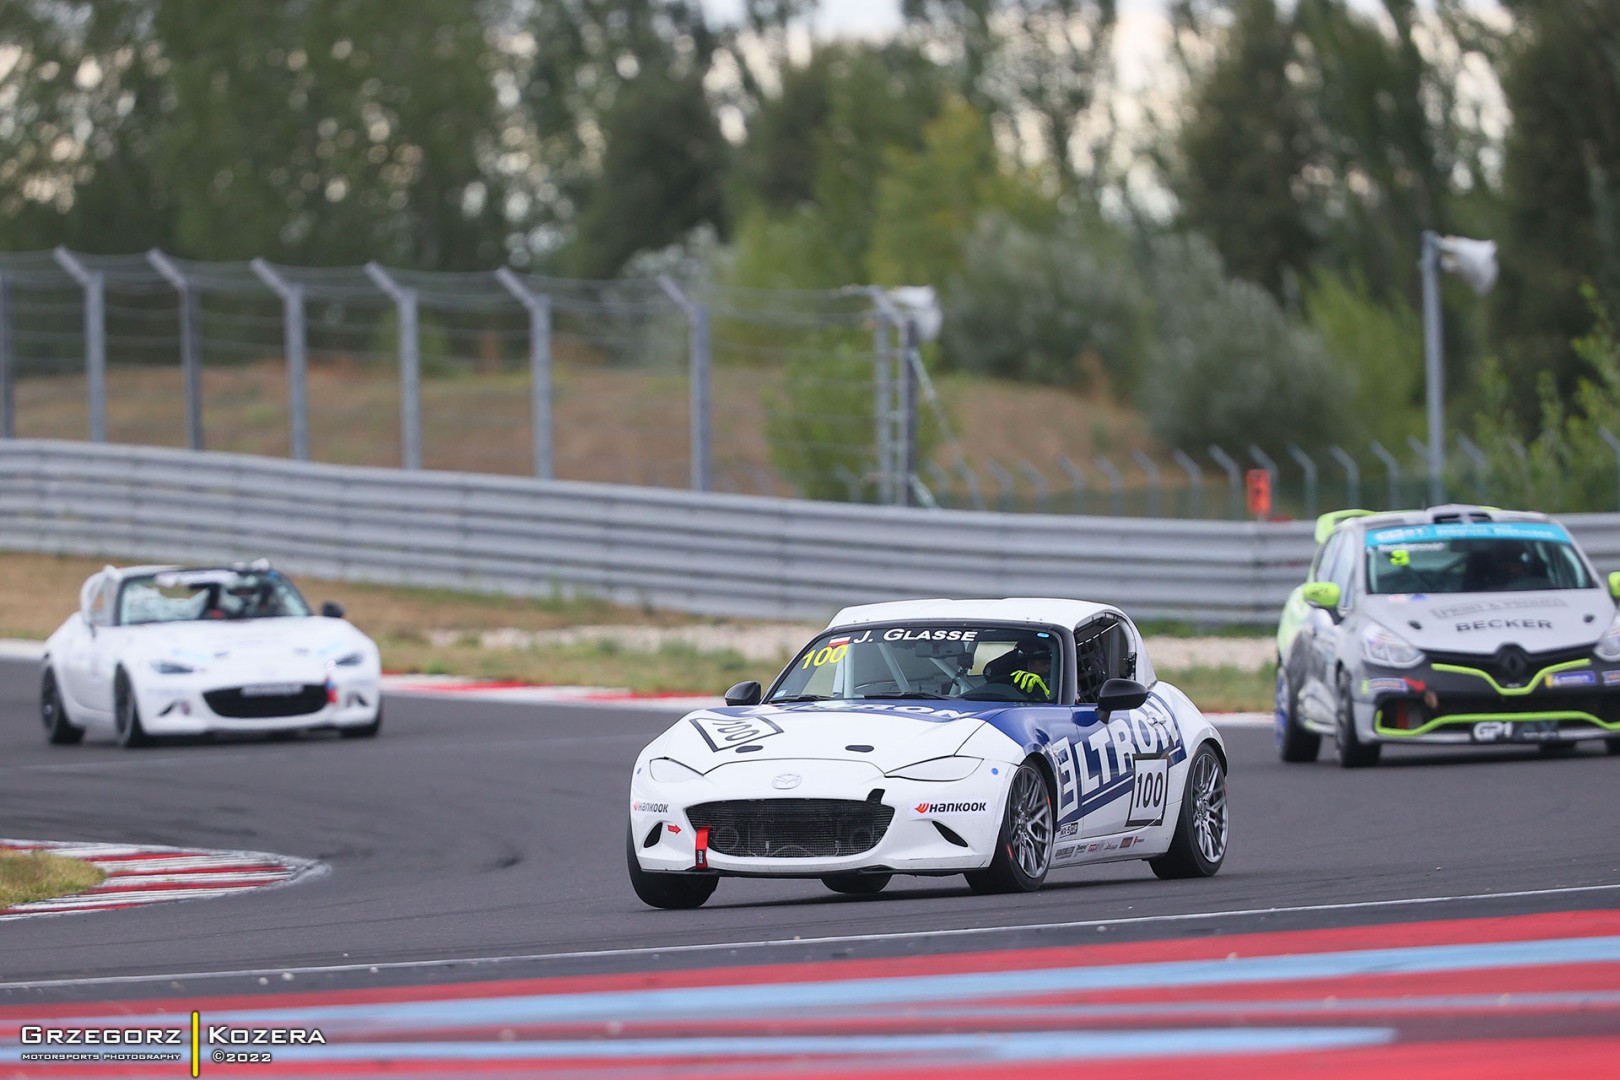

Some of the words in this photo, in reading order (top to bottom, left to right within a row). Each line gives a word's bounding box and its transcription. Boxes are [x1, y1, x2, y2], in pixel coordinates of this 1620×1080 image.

[1390, 549, 1411, 567] 3
[1455, 619, 1553, 633] BECKER
[853, 630, 874, 644] J.
[883, 628, 978, 642] GLASSE
[802, 644, 849, 670] 100
[711, 721, 761, 742] 100
[1050, 695, 1180, 823] ELTRON
[1134, 771, 1164, 809] 100
[929, 802, 987, 813] HANKOOK
